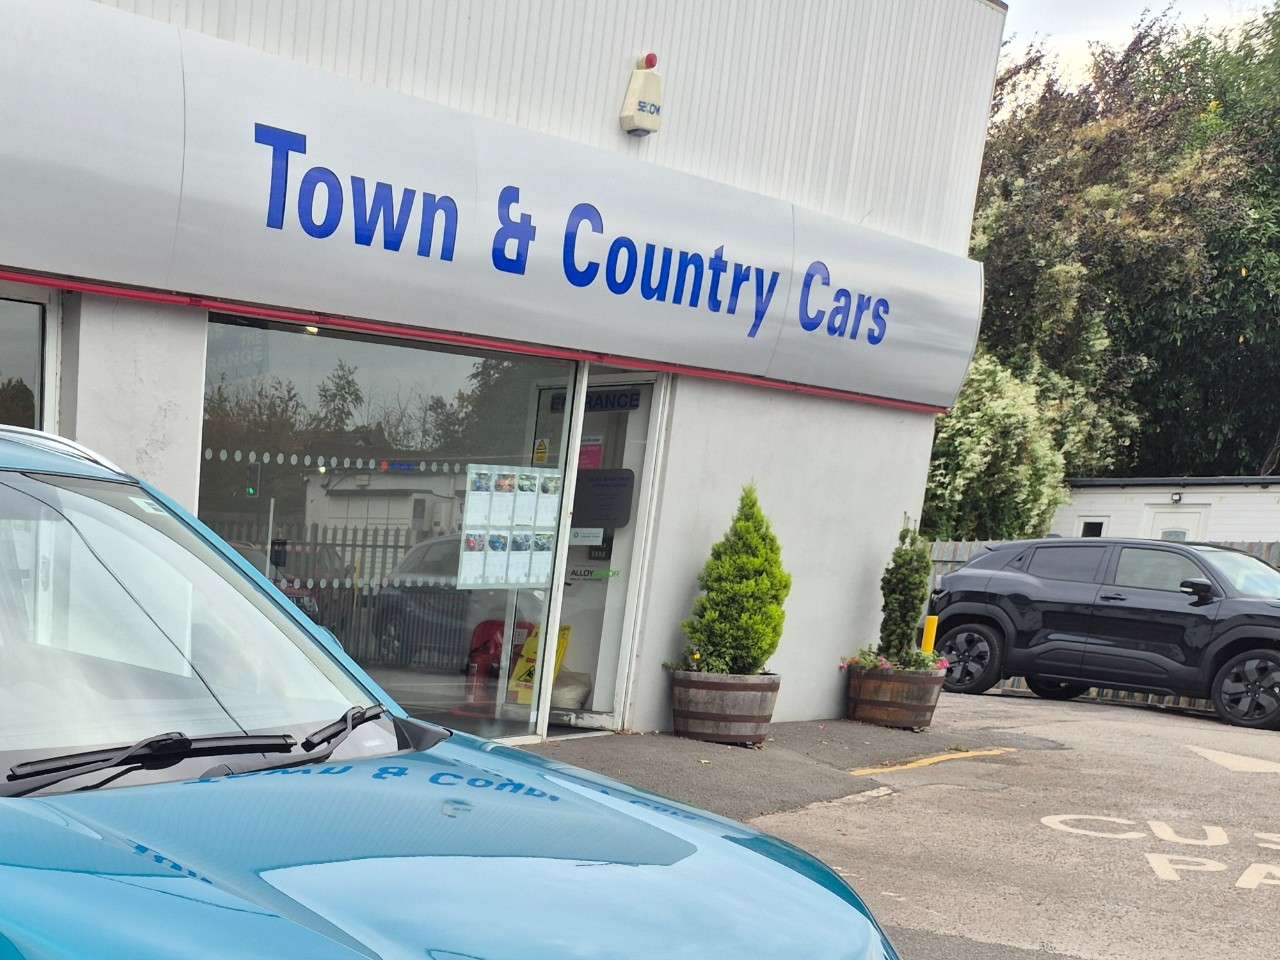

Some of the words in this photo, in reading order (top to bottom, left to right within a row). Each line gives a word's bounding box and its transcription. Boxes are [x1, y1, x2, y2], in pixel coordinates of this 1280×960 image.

[254, 122, 458, 262] Town
[492, 185, 536, 275] &
[562, 203, 781, 338] Country
[798, 261, 890, 345] Cars
